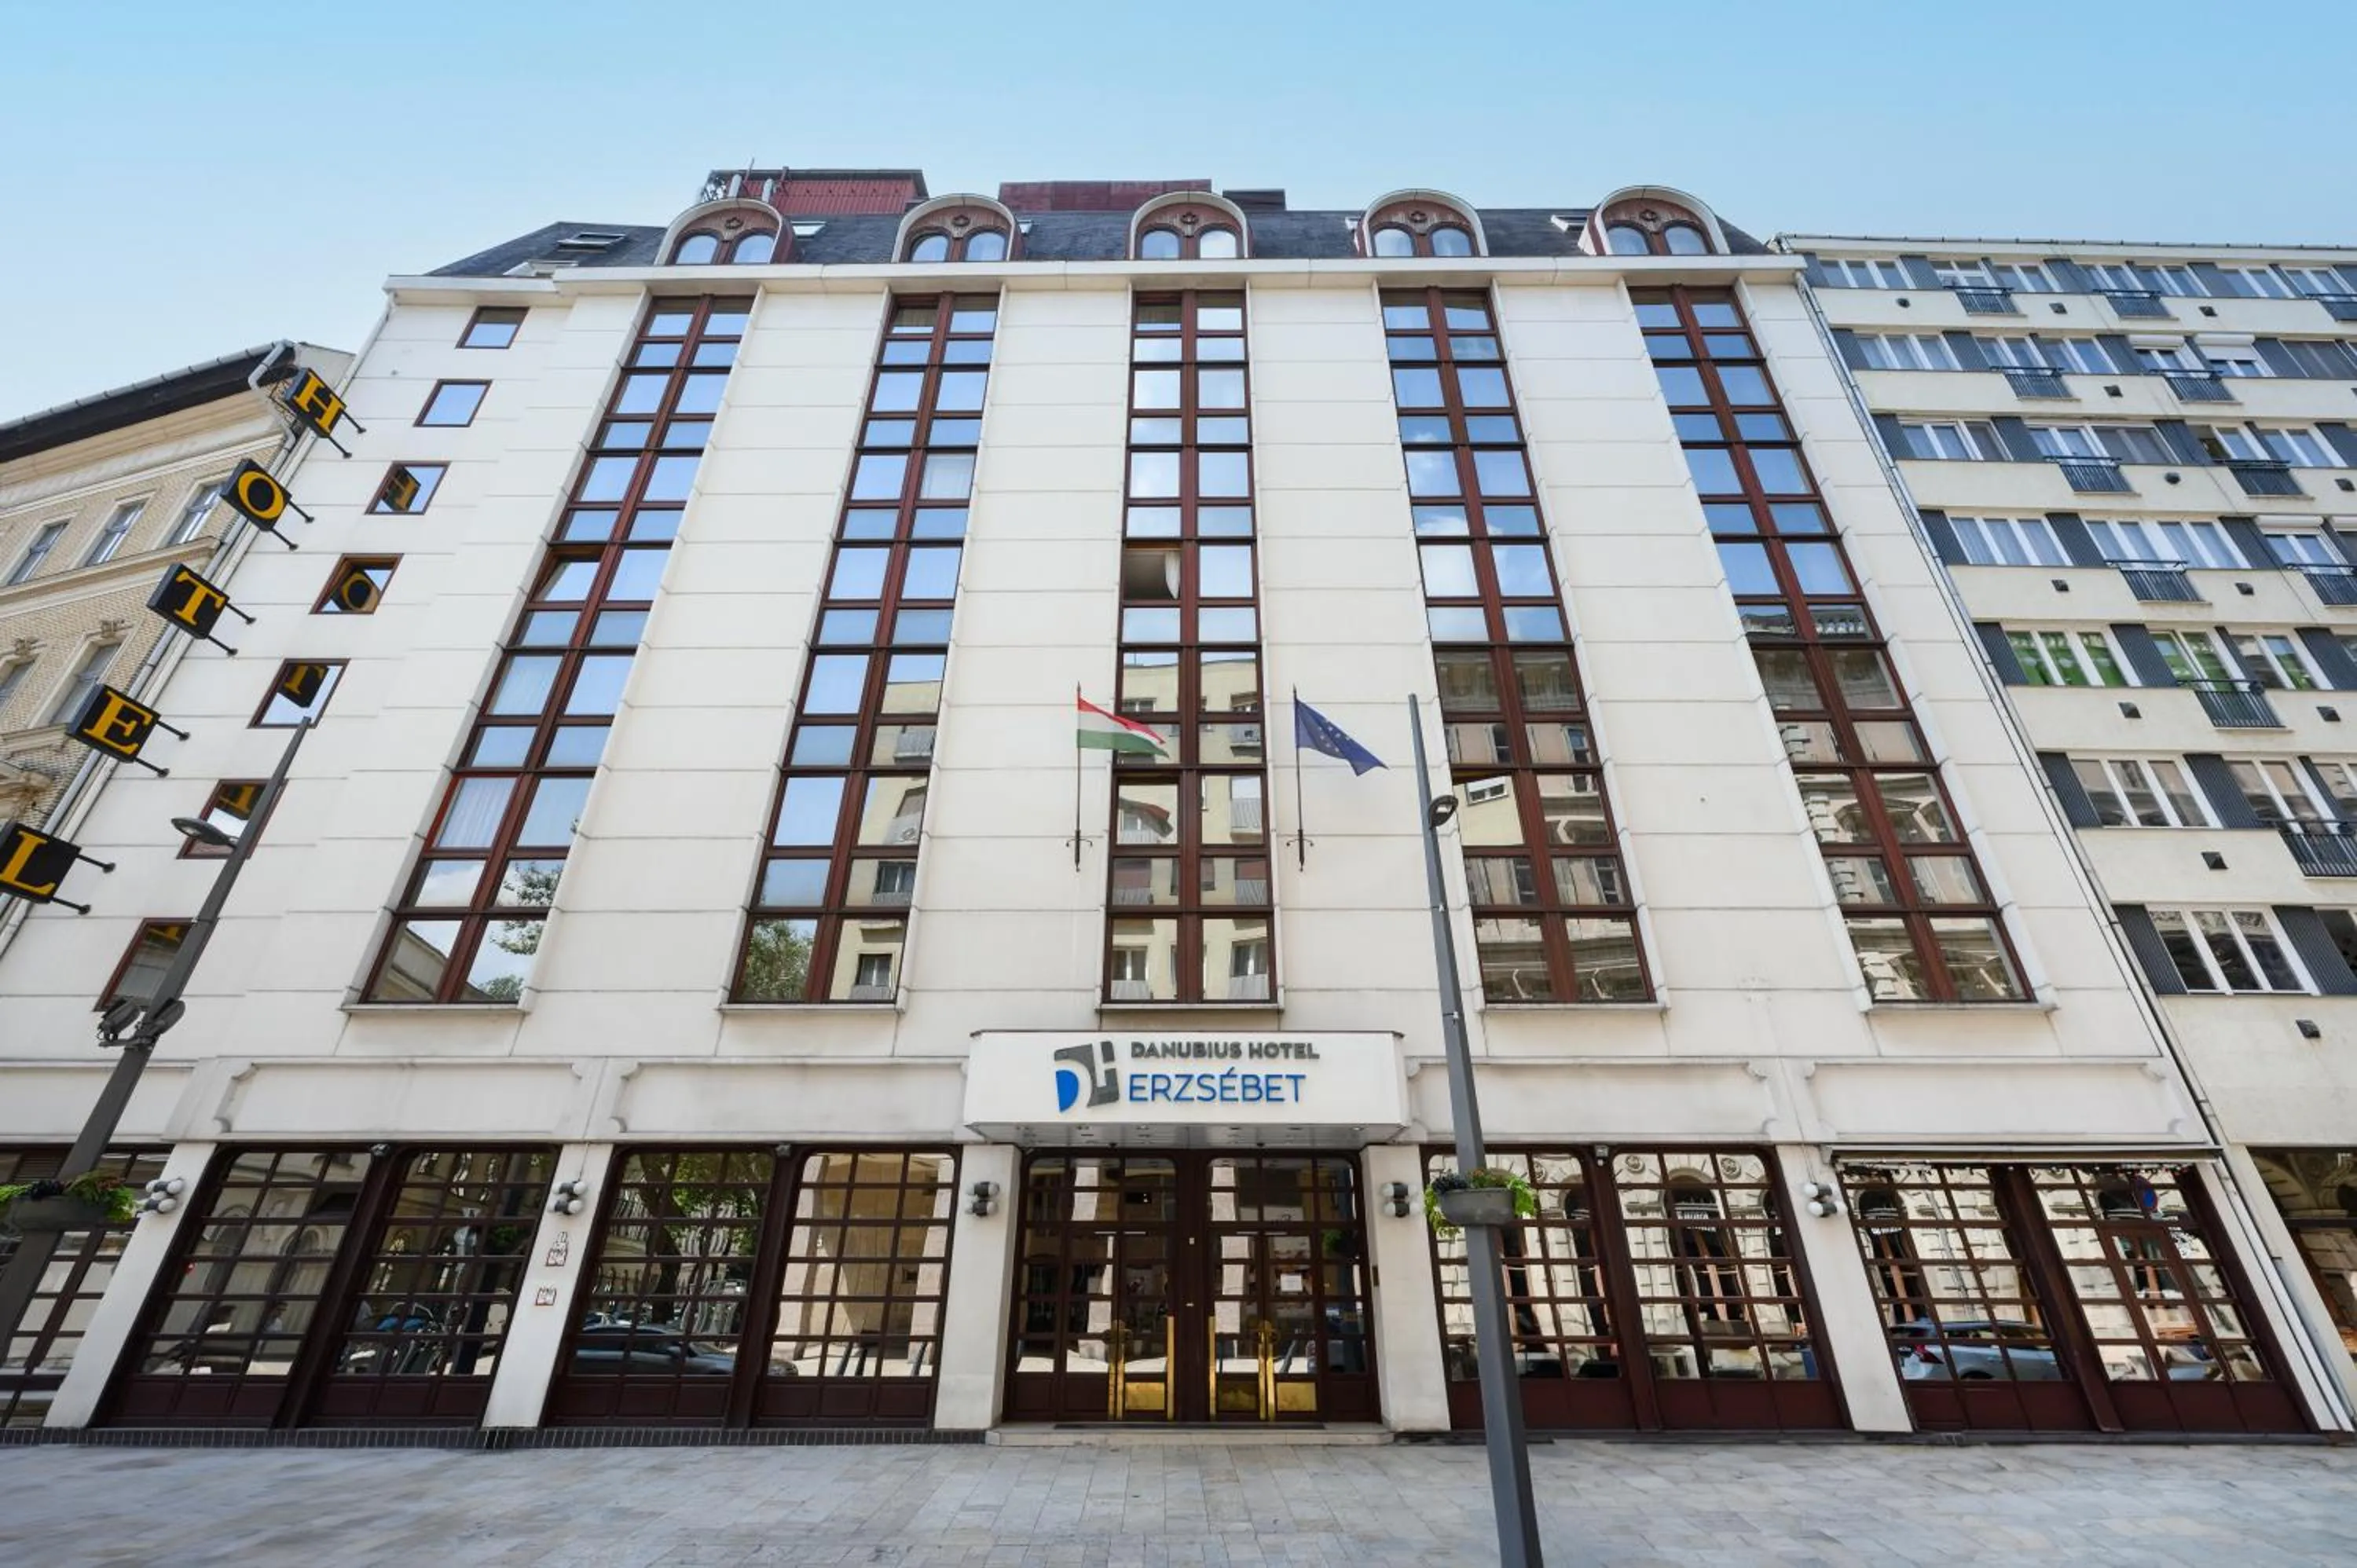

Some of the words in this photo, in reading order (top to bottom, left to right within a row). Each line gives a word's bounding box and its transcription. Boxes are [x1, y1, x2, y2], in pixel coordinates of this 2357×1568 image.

[0, 369, 344, 894] HOTEL
[1131, 1041, 1243, 1060] DANUBIUS
[1248, 1042, 1320, 1060] HOTEL
[1127, 1066, 1307, 1103] ERZSÉBET
